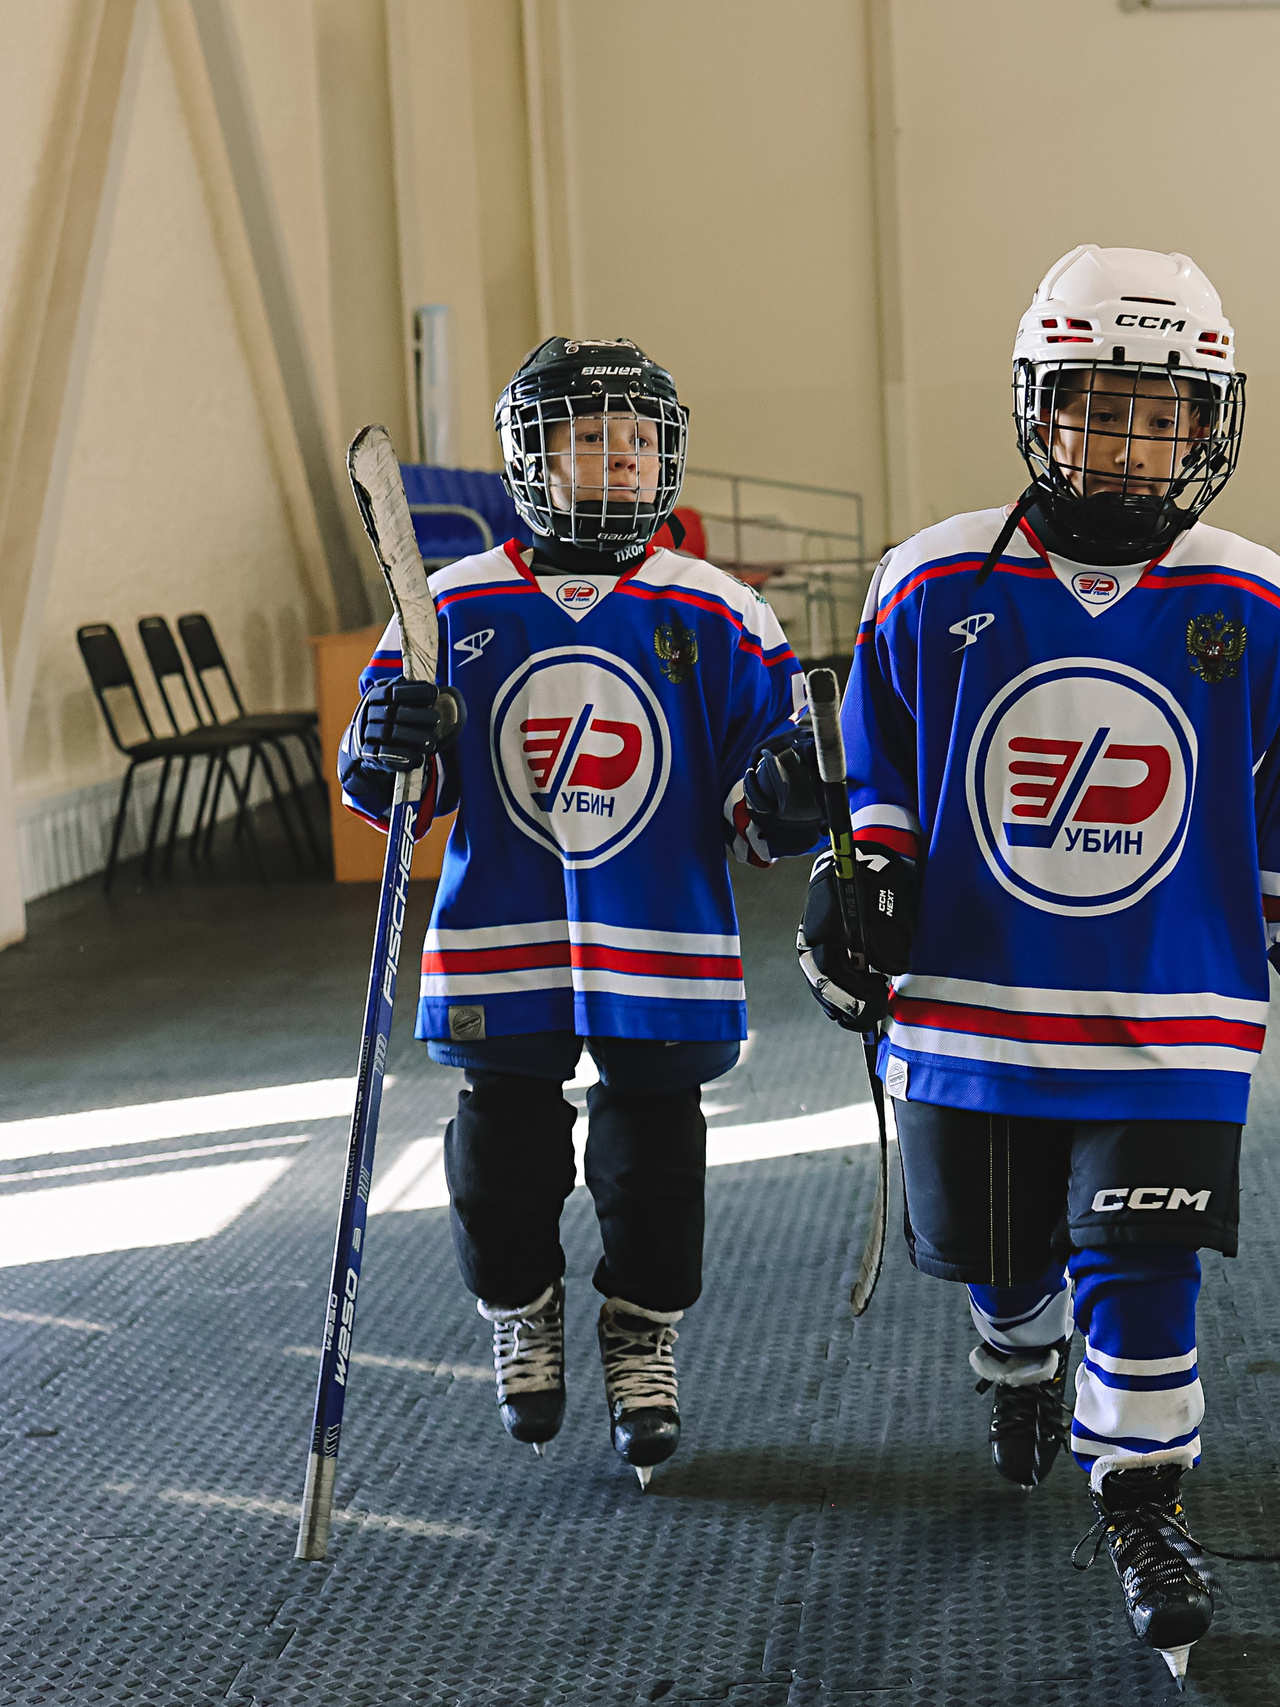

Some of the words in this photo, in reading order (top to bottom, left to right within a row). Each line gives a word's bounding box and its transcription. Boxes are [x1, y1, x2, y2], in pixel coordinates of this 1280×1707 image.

[1115, 314, 1186, 332] CCM
[581, 366, 642, 376] BAUER
[597, 531, 639, 540] BAUE
[561, 792, 615, 817] УБИН
[1064, 827, 1143, 855] УБИН
[383, 804, 417, 1007] FISCHER
[886, 889, 894, 917] NEXT
[1091, 1188, 1212, 1212] CCM
[334, 1268, 358, 1386] W250
